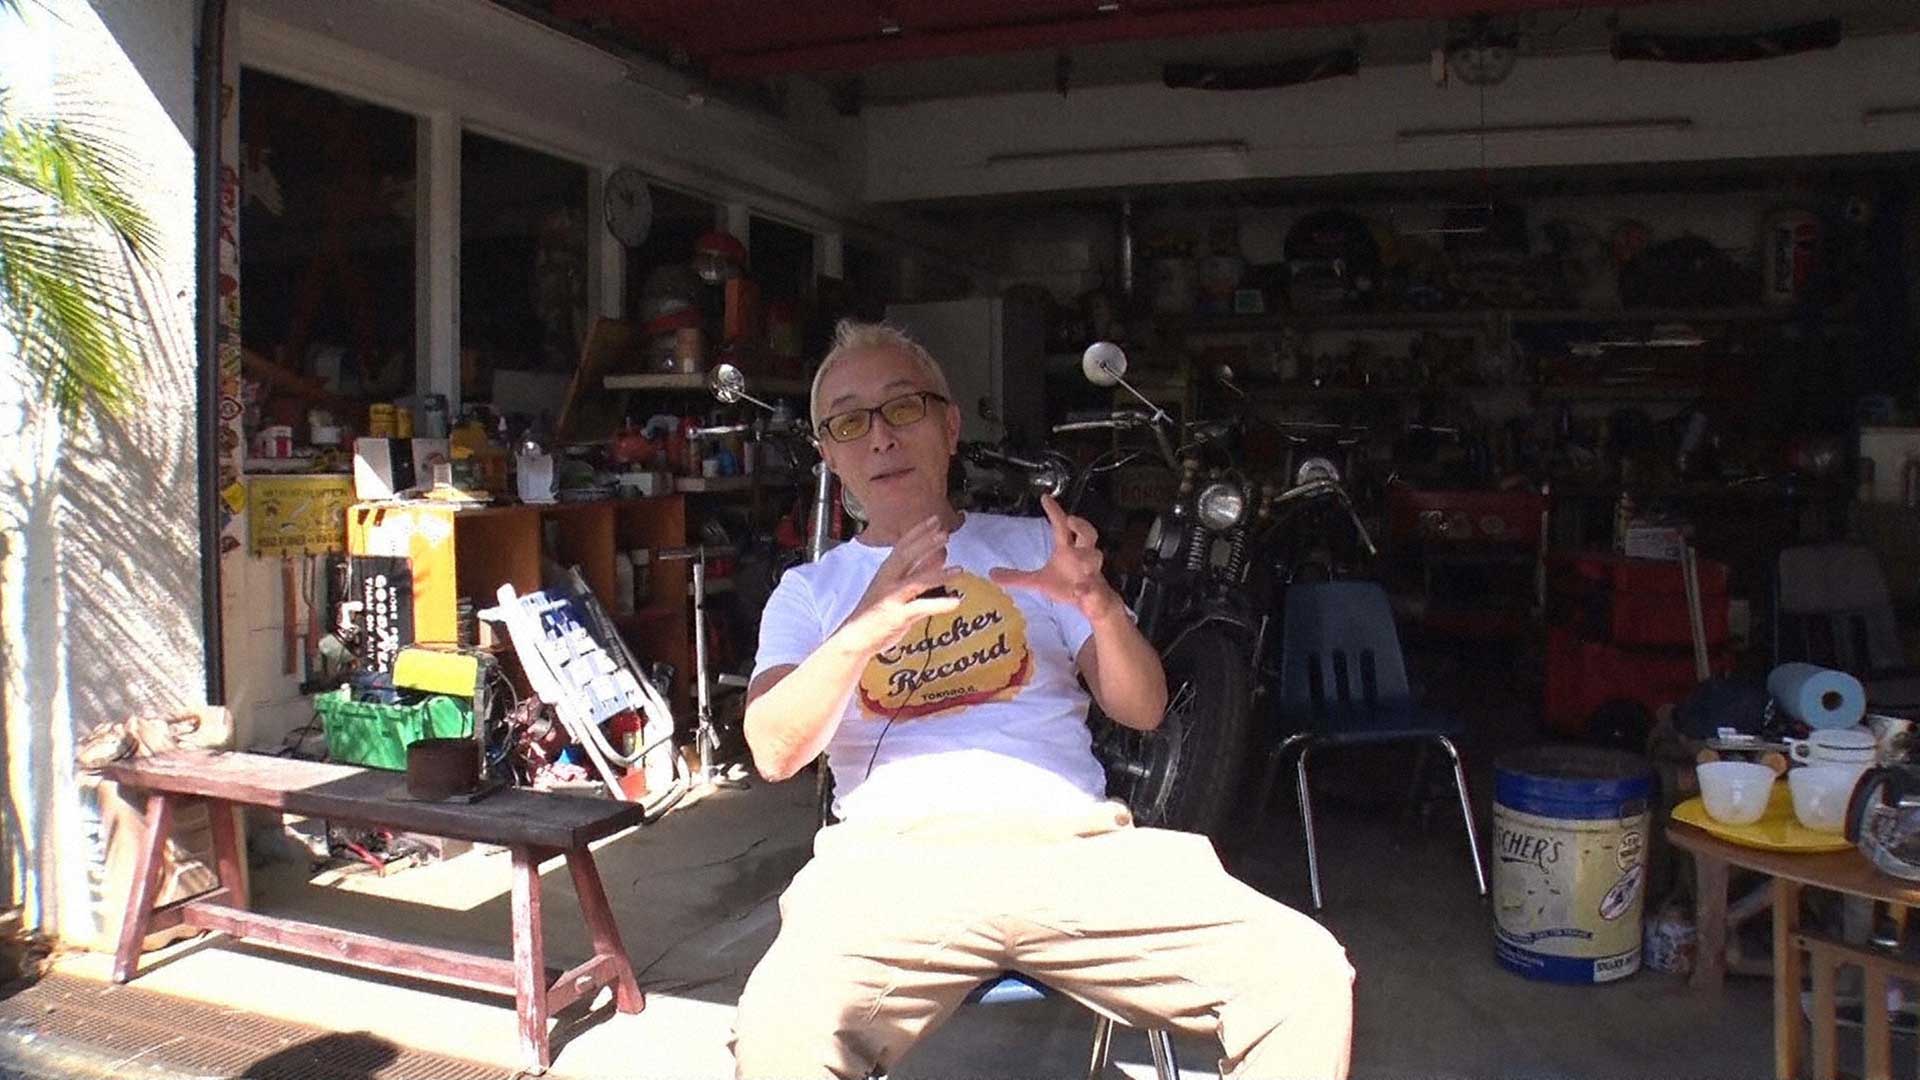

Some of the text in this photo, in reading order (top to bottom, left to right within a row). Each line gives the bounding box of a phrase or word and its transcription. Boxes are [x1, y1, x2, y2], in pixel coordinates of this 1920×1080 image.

[364, 577, 374, 611] THAN
[389, 587, 398, 619] MORE
[366, 614, 374, 632] ON
[375, 574, 389, 673] GOODYEA
[877, 609, 1003, 664] Cracker
[367, 635, 375, 660] ANY
[888, 633, 1011, 696] Record
[1495, 827, 1563, 875] CHER'S
